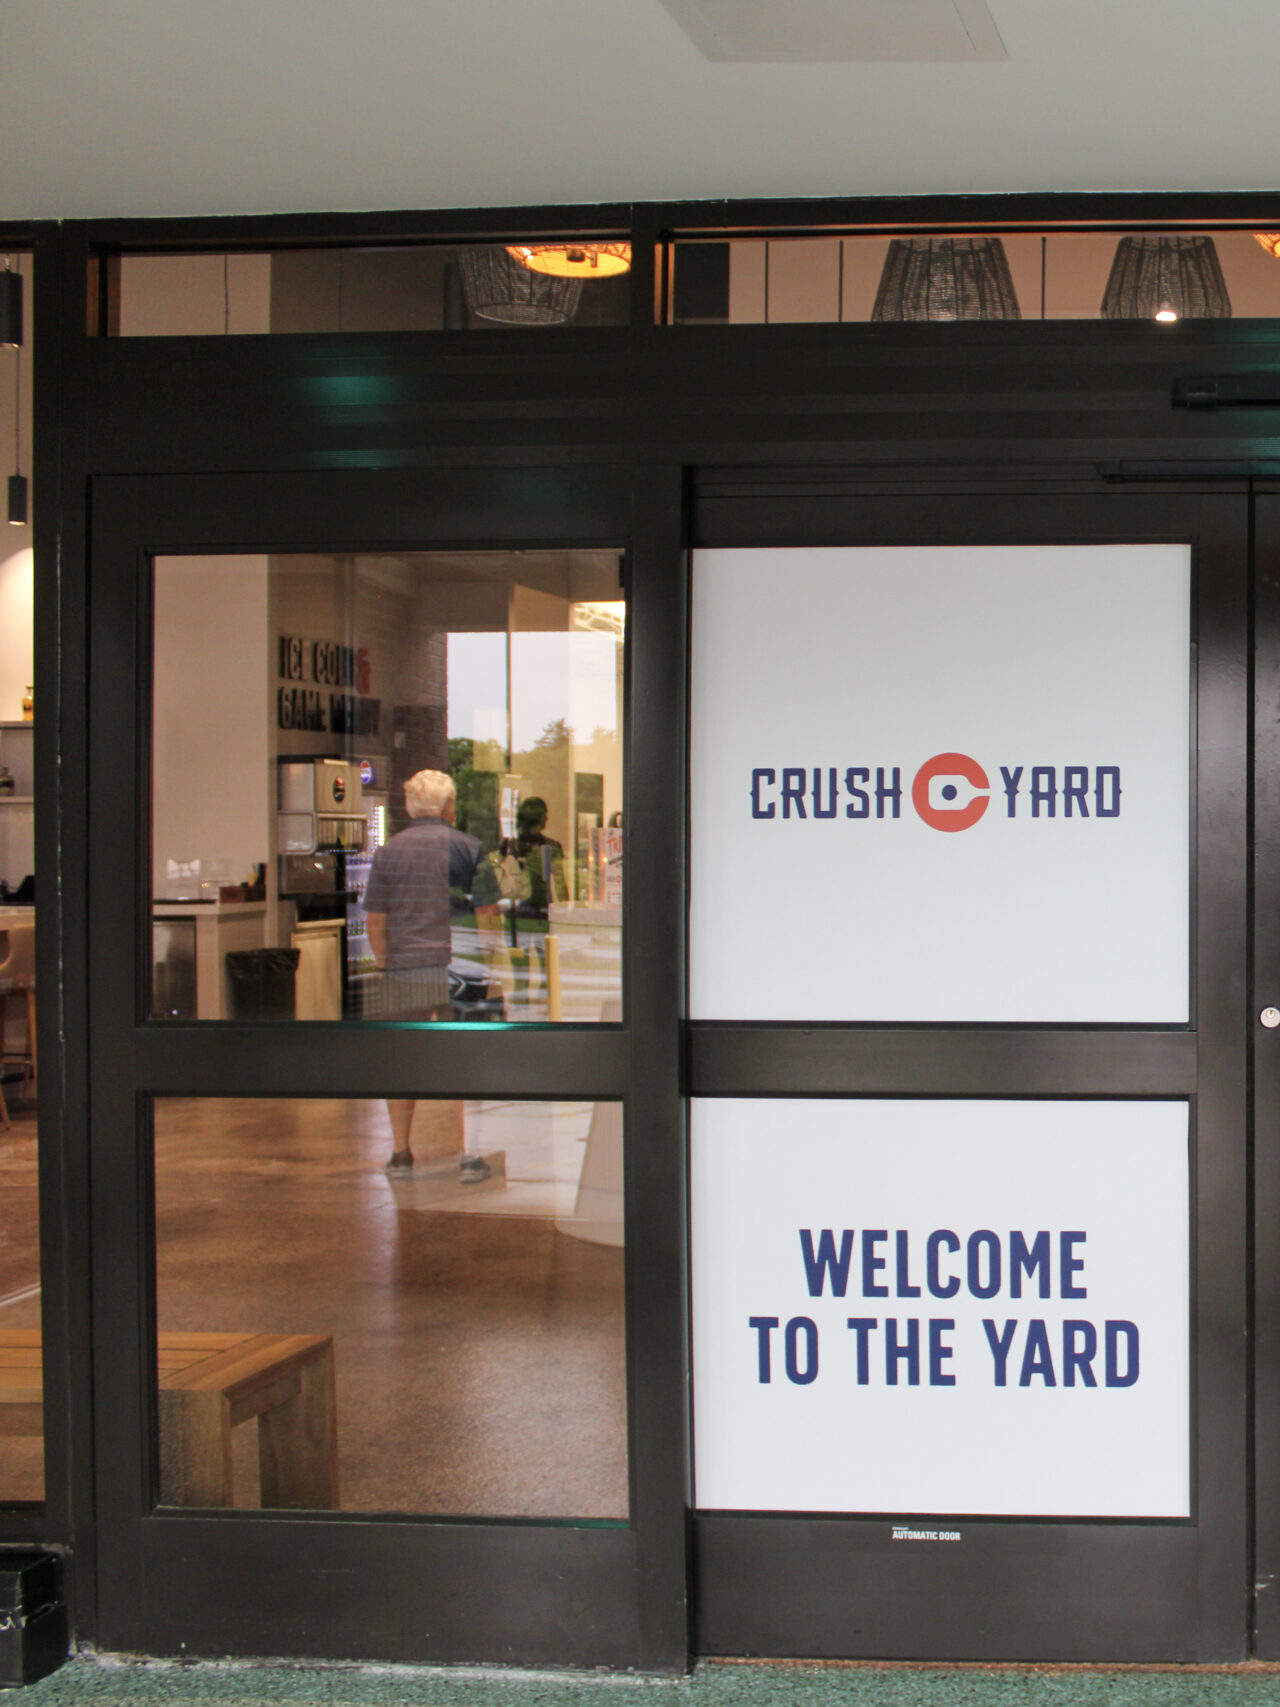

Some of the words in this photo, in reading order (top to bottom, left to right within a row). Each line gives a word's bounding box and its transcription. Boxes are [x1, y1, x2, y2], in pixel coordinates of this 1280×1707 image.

[749, 766, 902, 819] CRUSH
[999, 765, 1122, 817] YARD
[798, 1228, 1087, 1299] WELCOME
[748, 1315, 818, 1385] TO
[846, 1317, 955, 1386] THE
[981, 1318, 1139, 1387] YARD
[892, 1530, 938, 1540] AUTOMATIC
[939, 1531, 961, 1541] DOOR
